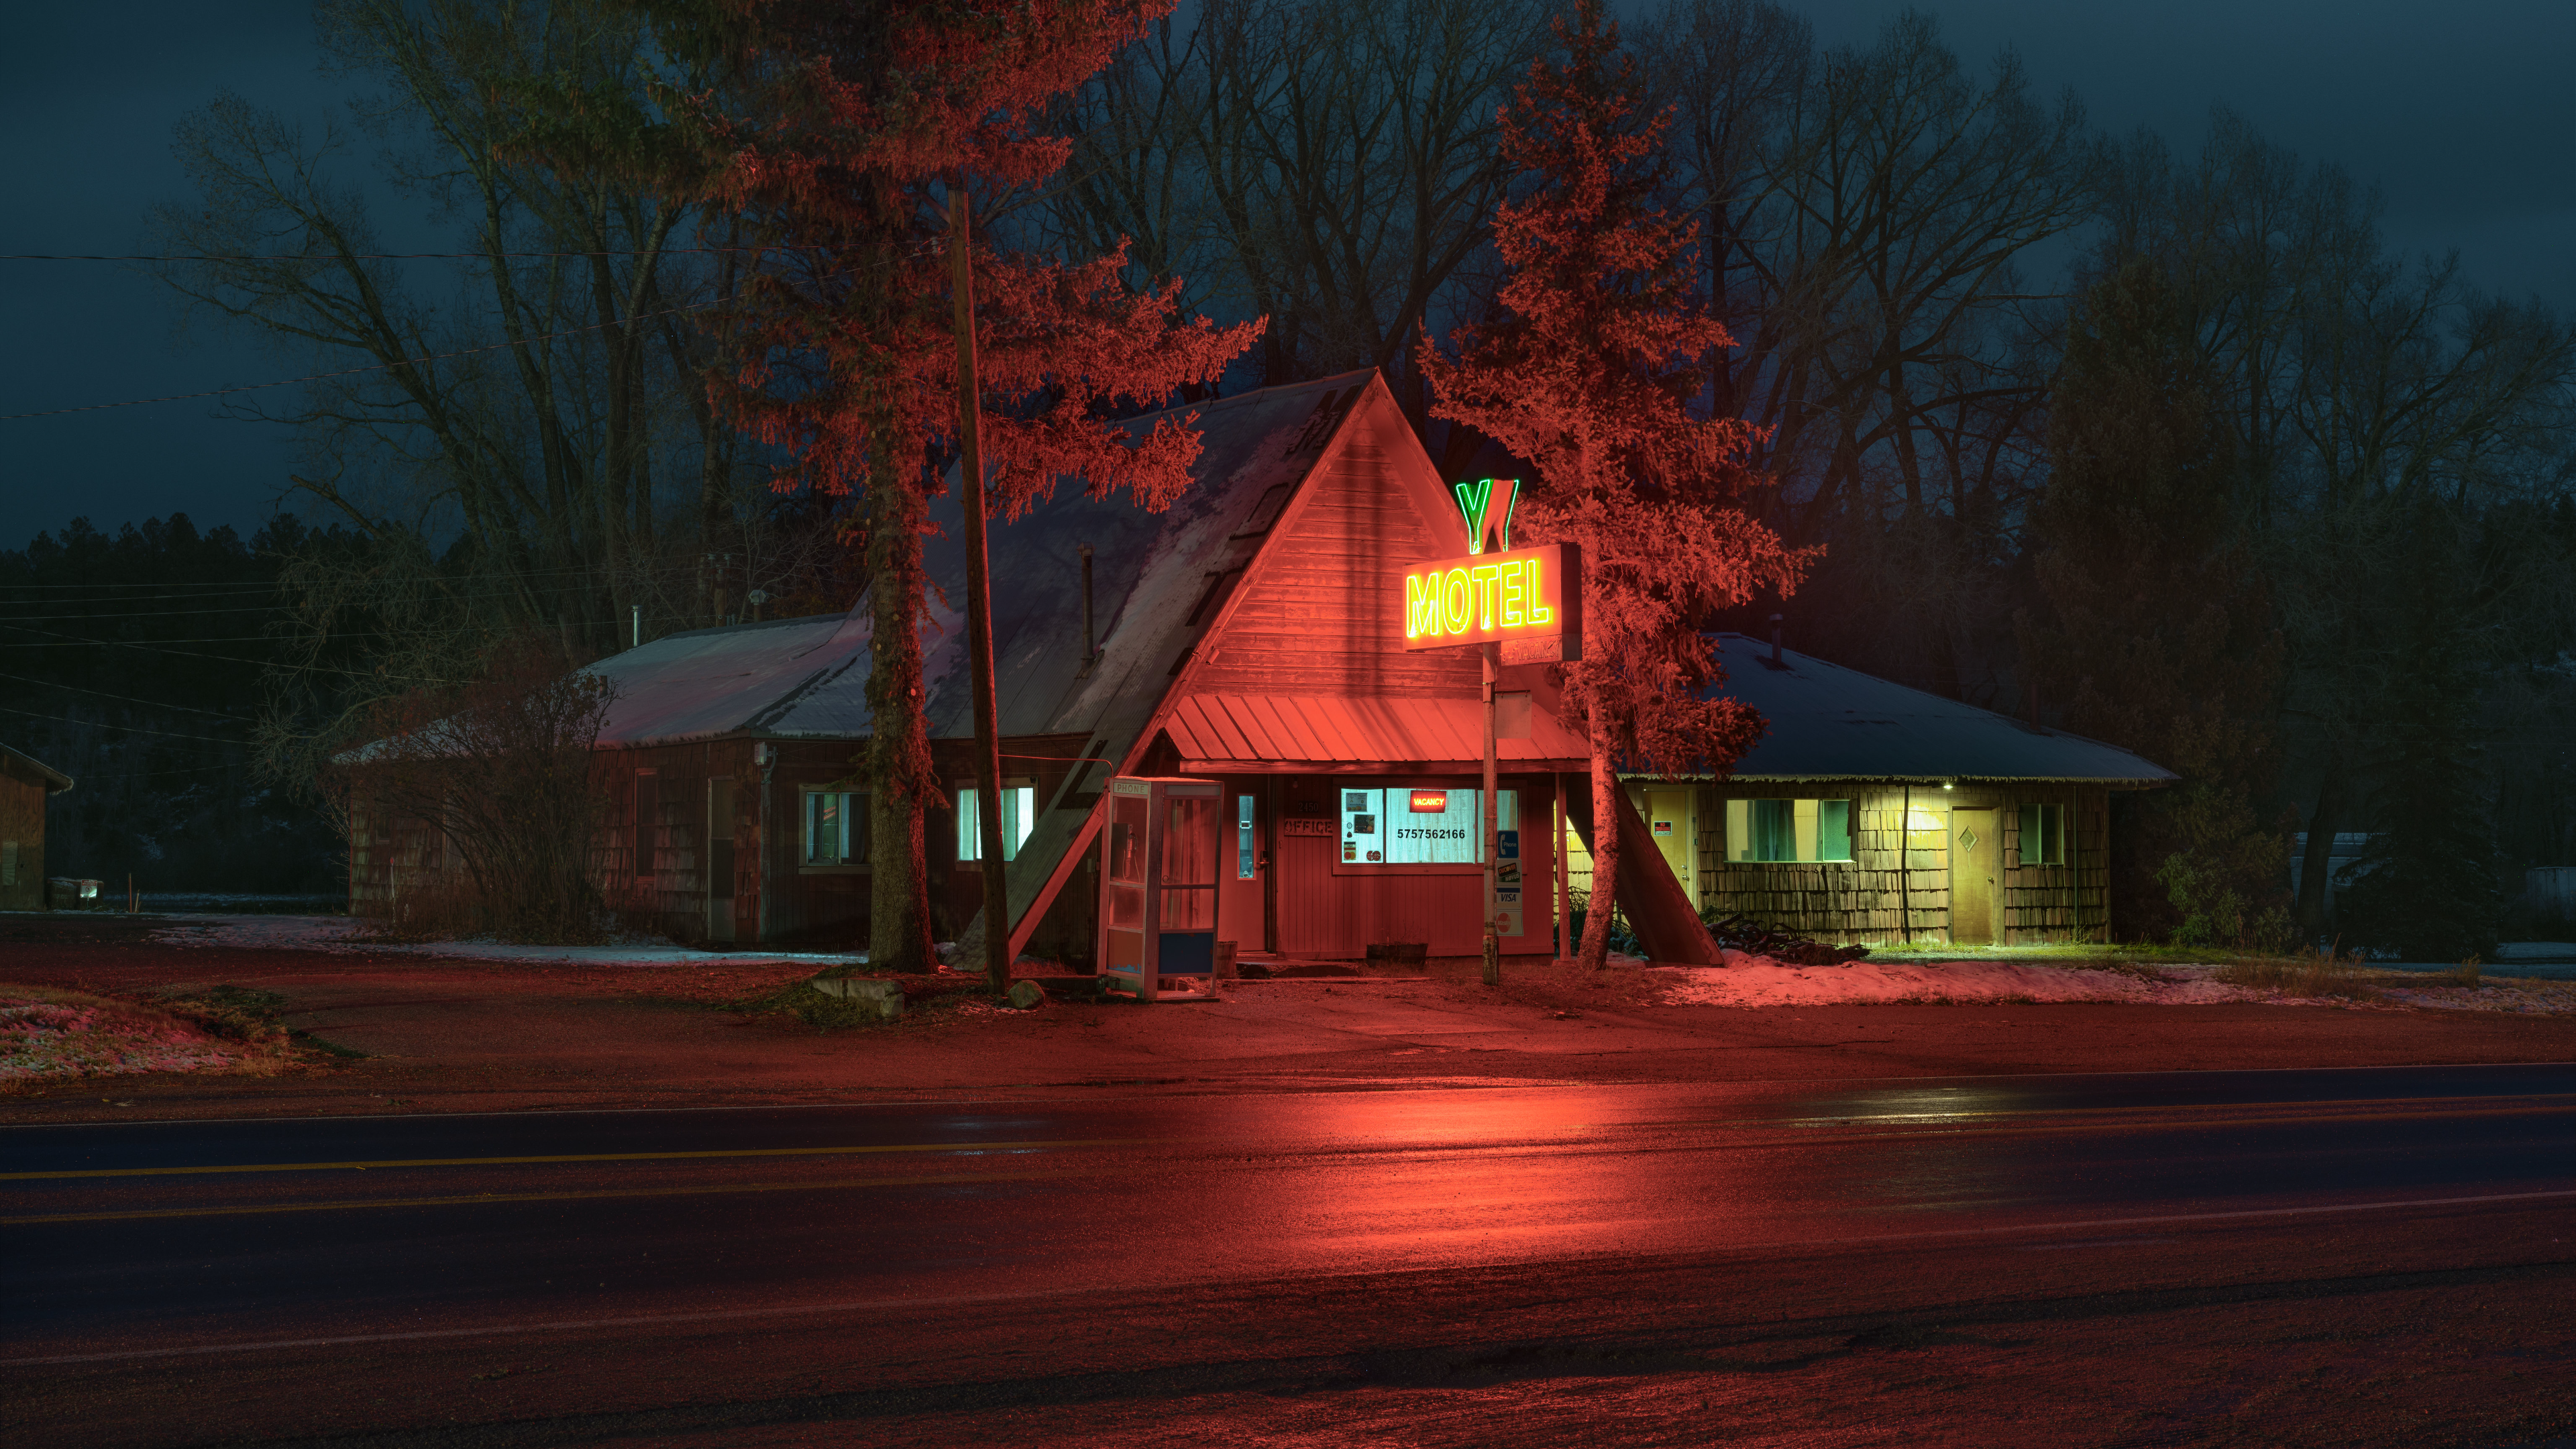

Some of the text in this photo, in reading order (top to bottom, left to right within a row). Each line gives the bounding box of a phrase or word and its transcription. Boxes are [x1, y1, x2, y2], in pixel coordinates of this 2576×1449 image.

[1406, 558, 1554, 639] MOTEL
[1517, 639, 1561, 661] VACANCY
[1117, 784, 1144, 793] PHONE
[1298, 802, 1318, 812] 2450
[1413, 798, 1444, 806] VACANCY
[1285, 820, 1333, 833] OFFICE
[1397, 828, 1465, 839] 5757562166
[1505, 873, 1519, 882] NOVUS
[1501, 894, 1517, 902] VISA
